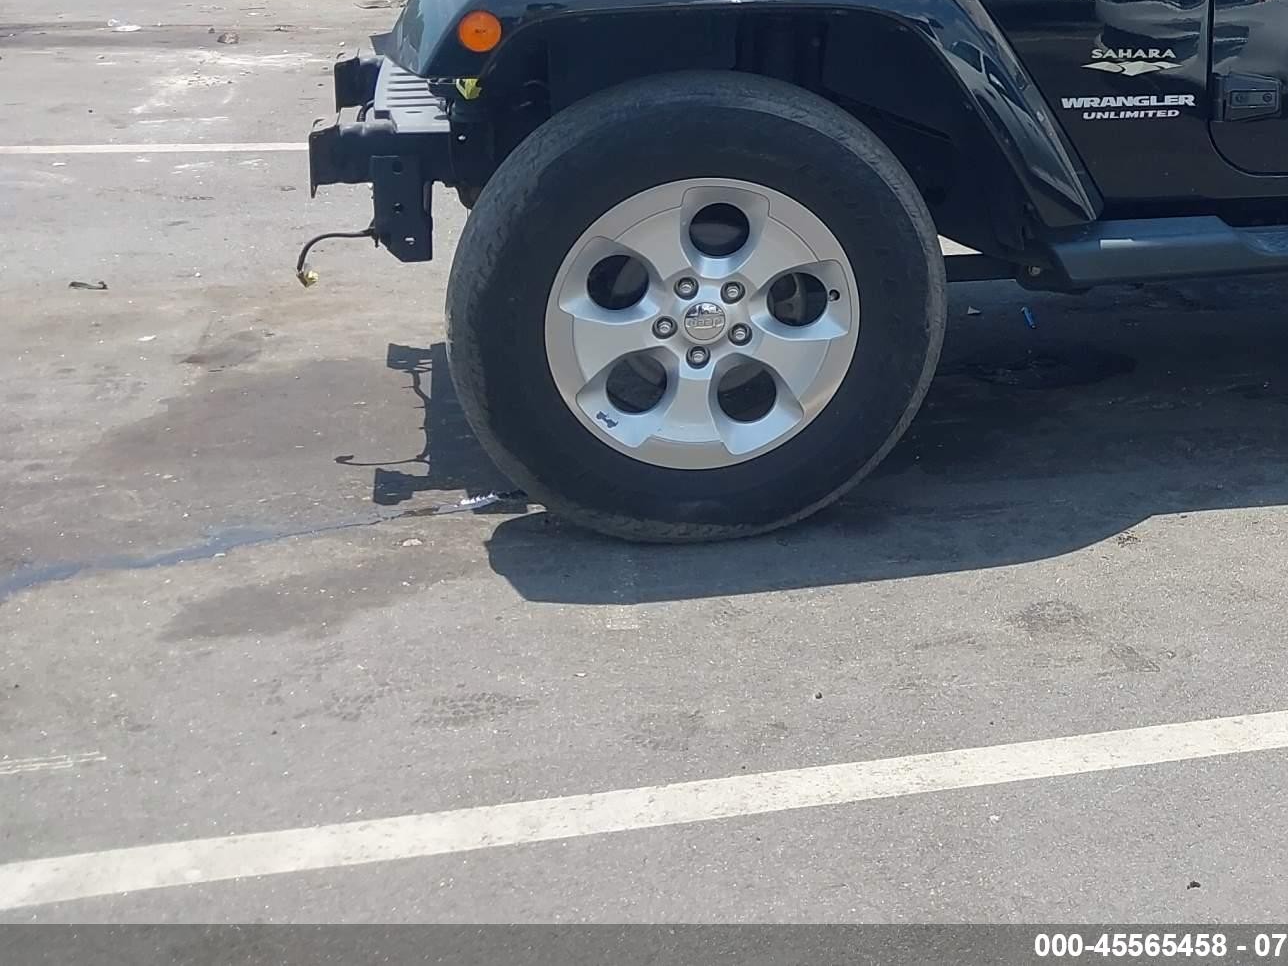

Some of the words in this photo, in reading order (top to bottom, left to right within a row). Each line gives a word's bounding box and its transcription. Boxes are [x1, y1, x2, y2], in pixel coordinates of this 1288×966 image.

[1091, 48, 1177, 59] SAHARA
[1061, 94, 1196, 109] WRANGLER
[1083, 110, 1180, 120] UNLIMITED
